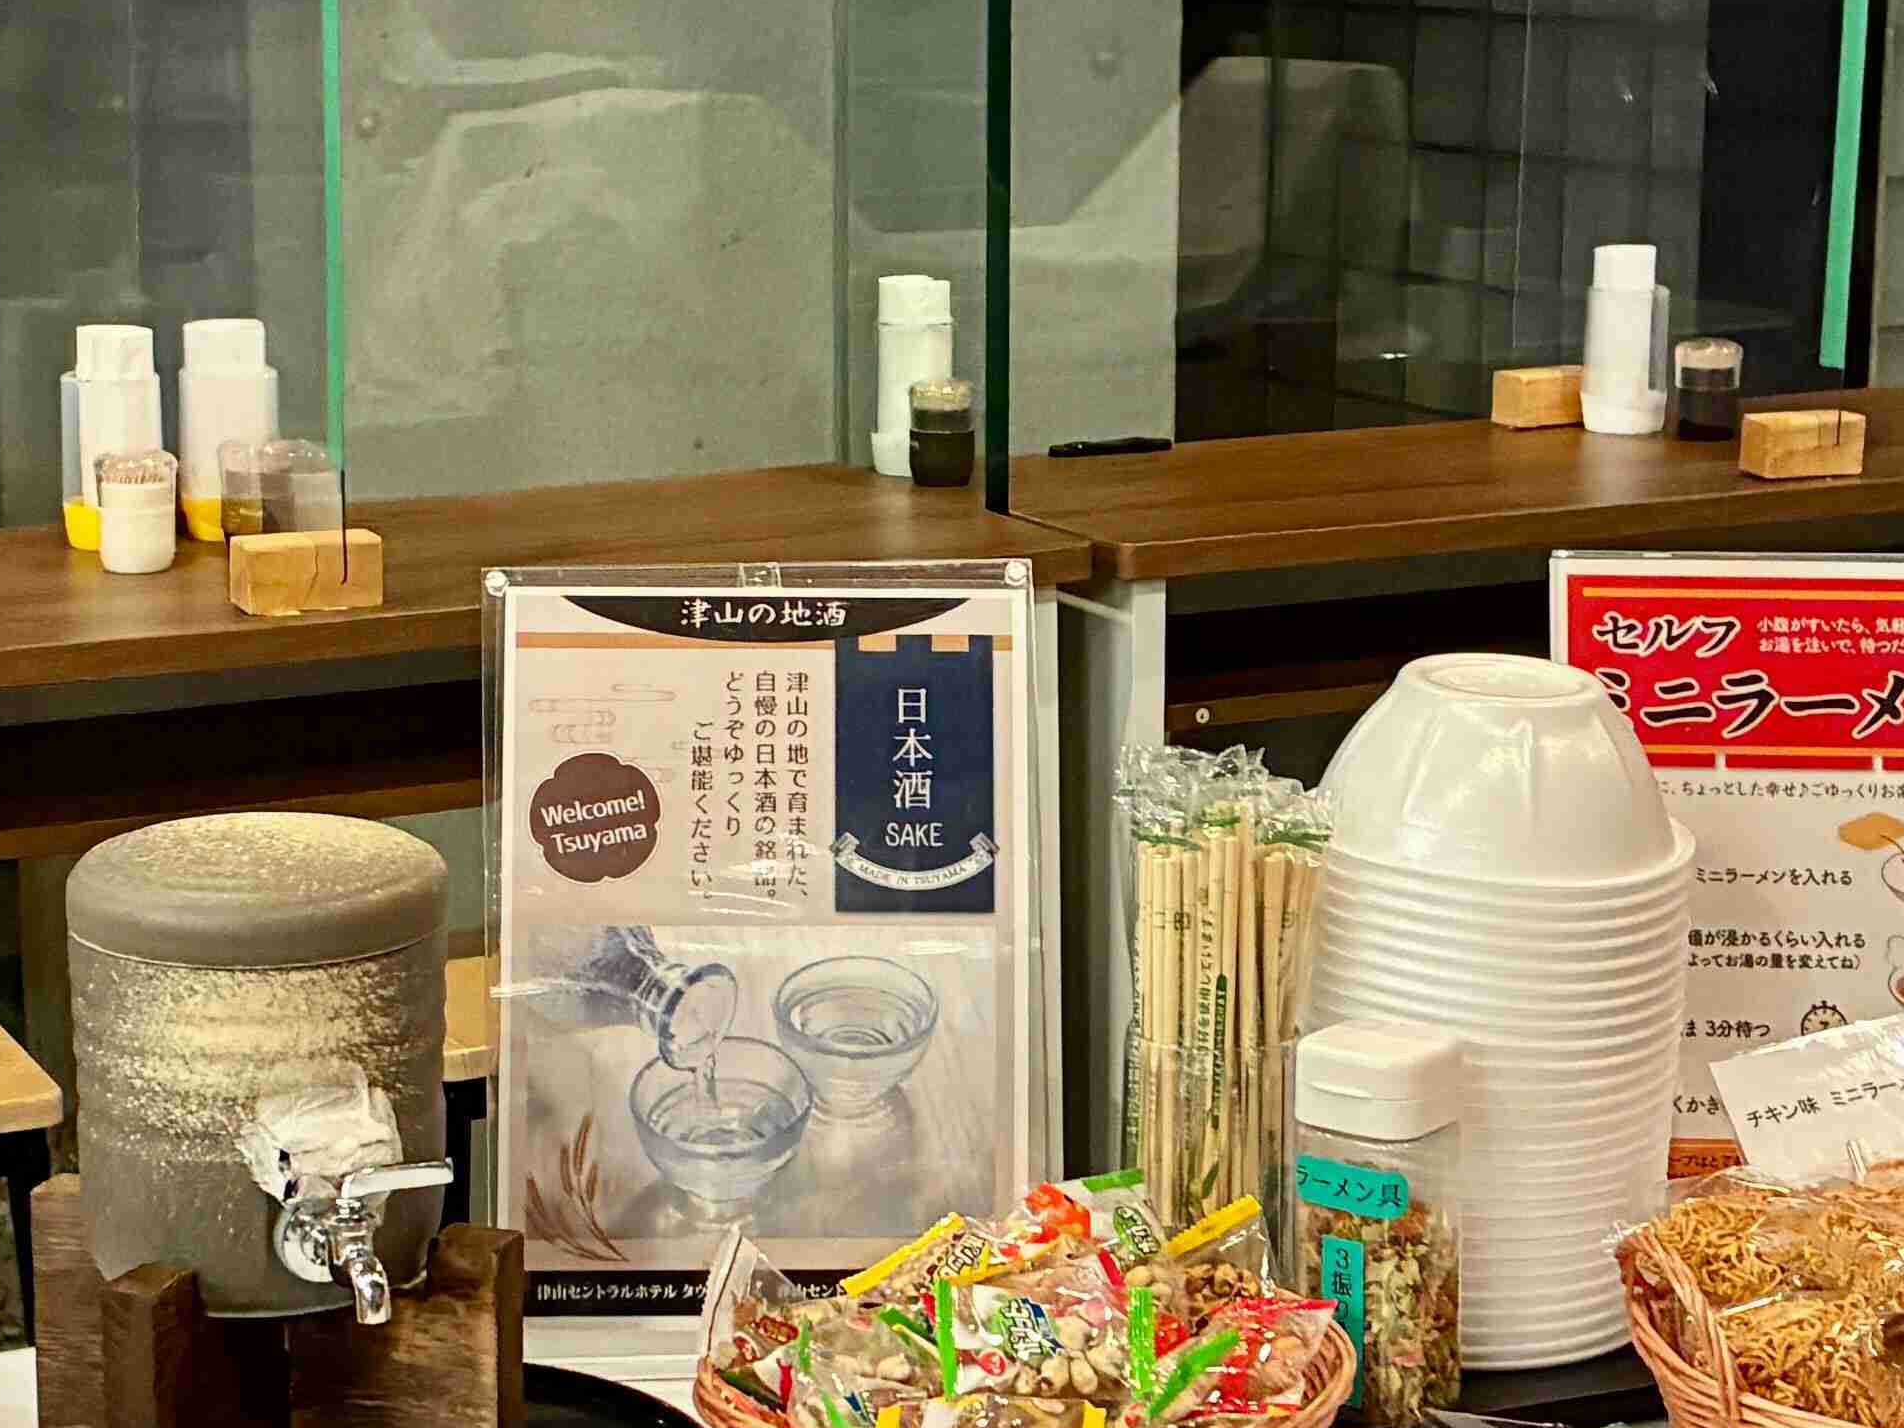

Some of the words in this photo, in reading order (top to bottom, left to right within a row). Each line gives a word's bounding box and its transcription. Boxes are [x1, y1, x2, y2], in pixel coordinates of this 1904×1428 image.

[680, 600, 848, 630] 津山の地酒
[1593, 612, 1741, 658] セルフ
[724, 671, 745, 837] どうぞゆっくり
[892, 687, 933, 811] 日本酒
[786, 672, 809, 898] 津山の地で育まれた、
[540, 792, 645, 828] Welcome!
[690, 720, 713, 900] ご堪能ください。
[551, 821, 648, 856] Tsuyama
[885, 822, 944, 847] SAKE
[1696, 867, 1853, 886] ミニラーメンを入れる
[1746, 1096, 1821, 1128] チキン味
[1296, 1165, 1402, 1208] ラーメン具
